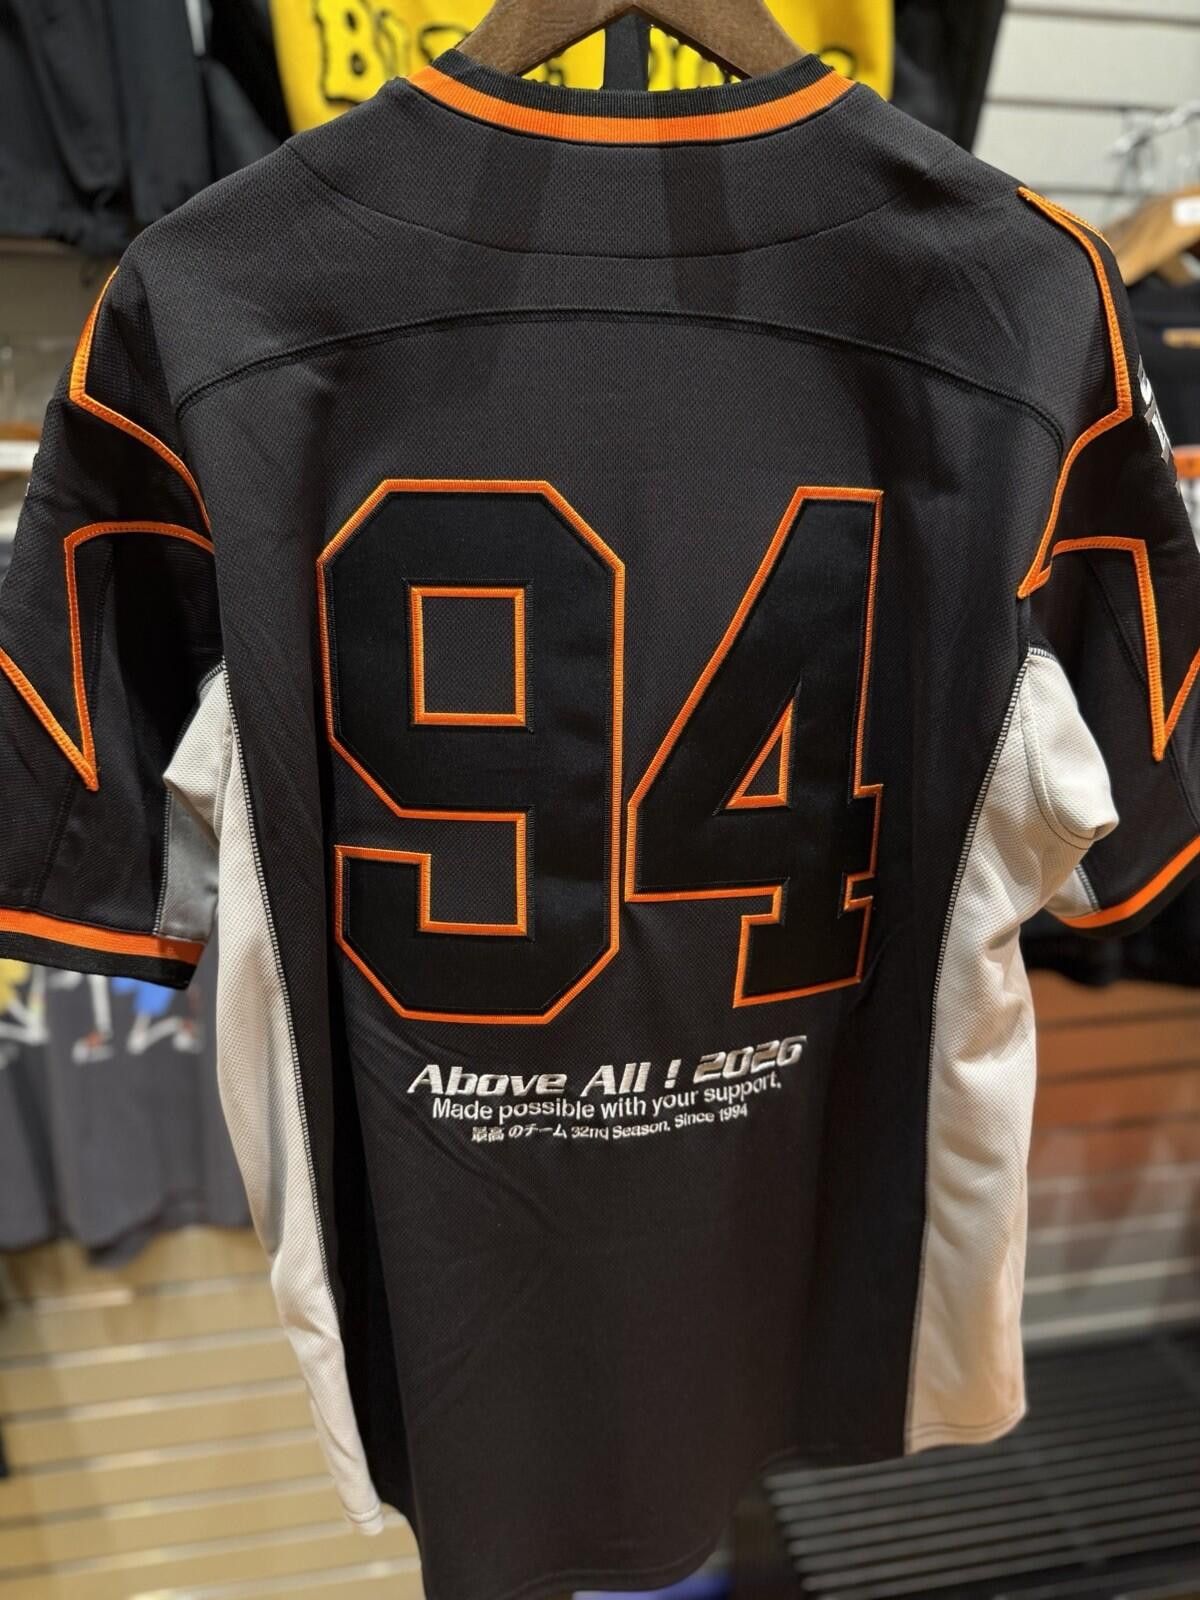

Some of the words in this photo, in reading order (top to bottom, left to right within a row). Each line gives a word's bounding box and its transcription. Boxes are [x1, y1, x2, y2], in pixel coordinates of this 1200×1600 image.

[316, 478, 884, 1024] 94
[407, 1064, 568, 1097] Above
[580, 1062, 651, 1097] All
[664, 1059, 682, 1089] !
[693, 1035, 808, 1084] 2026
[432, 1097, 494, 1121] Made
[498, 1098, 596, 1125] possible
[600, 1097, 646, 1120] with
[652, 1090, 699, 1118] your
[570, 1126, 609, 1140] 32nd
[674, 1110, 715, 1130] Since
[719, 1103, 749, 1122] 1994
